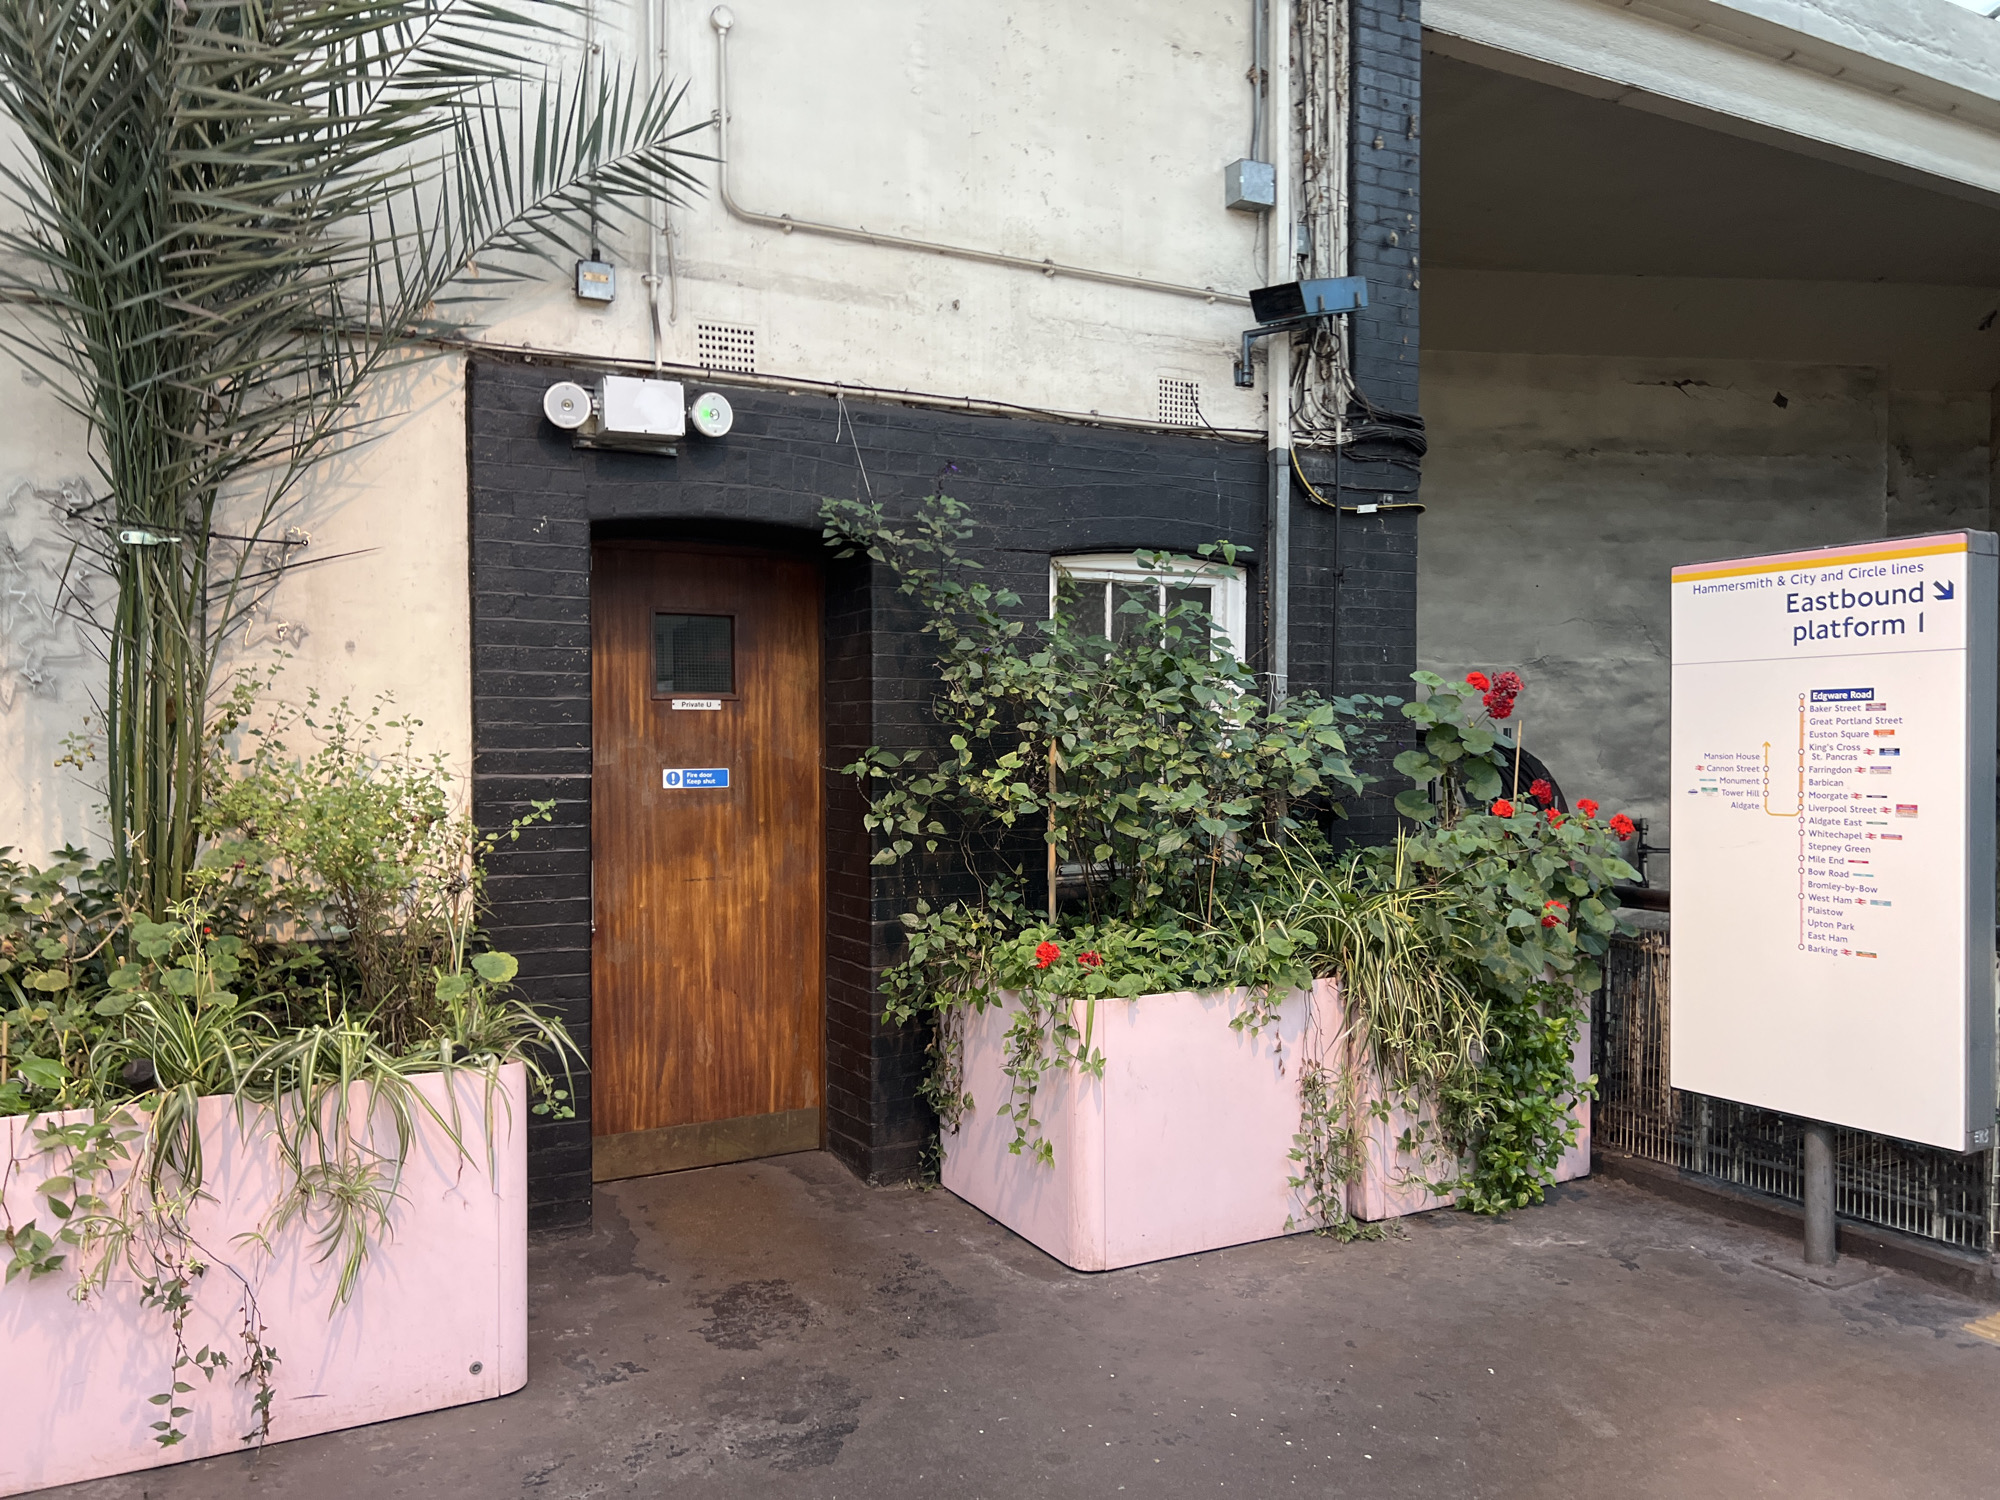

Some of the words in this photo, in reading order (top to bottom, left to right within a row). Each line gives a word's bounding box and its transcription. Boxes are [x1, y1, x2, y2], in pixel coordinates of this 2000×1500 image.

[1692, 577, 1773, 594] Hammersmith
[1777, 576, 1785, 586] &
[1790, 573, 1816, 586] City
[1820, 570, 1843, 582] and
[1848, 566, 1886, 579] Circle
[1891, 562, 1924, 575] lines
[1786, 581, 1923, 613] Eastbound
[1793, 616, 1905, 646] platform
[1918, 612, 1924, 633] 1
[1812, 691, 1848, 701] Edgware
[1850, 690, 1872, 700] Road
[1809, 704, 1832, 712] Baker
[1834, 703, 1861, 712] Street
[1809, 718, 1834, 726] Great
[1836, 717, 1873, 726] Portland
[1875, 717, 1904, 725] Street
[1809, 731, 1839, 739] Euston
[1841, 730, 1869, 739] Square
[1809, 744, 1834, 752] King's
[1836, 743, 1861, 752] Cross
[1704, 753, 1734, 761] Mansion
[1736, 753, 1761, 761] House
[1812, 753, 1823, 761] St.
[1707, 765, 1735, 773] Cannon
[1737, 765, 1761, 773] Street
[1809, 766, 1852, 775] Farringdon
[1720, 777, 1761, 786] Monument
[1809, 779, 1845, 787] Barbican
[1721, 789, 1743, 797] Tower
[1746, 789, 1760, 797] Hill
[1809, 791, 1848, 801] Moorgate
[1731, 802, 1760, 811] Aldgate
[1809, 804, 1847, 813] Liverpool
[1850, 806, 1878, 815] Street
[1809, 817, 1841, 826] Aldgate
[1844, 818, 1863, 827] East
[1808, 830, 1862, 840] Whitechapel
[1808, 843, 1842, 853] Stepney
[1845, 845, 1872, 854] Green
[1808, 855, 1827, 864] Mile
[1829, 857, 1845, 865] End
[1808, 868, 1827, 877] Bow
[1829, 870, 1850, 879] Road
[1808, 881, 1878, 893] Bromley-by-Bow
[1808, 893, 1830, 902] West
[1833, 896, 1853, 905] Ham
[1808, 906, 1843, 916] Plaistow
[1808, 919, 1834, 928] Upton
[1837, 922, 1855, 931] Park
[1808, 932, 1826, 941] East
[1829, 934, 1848, 943] Ham
[1808, 944, 1838, 956] Barking
